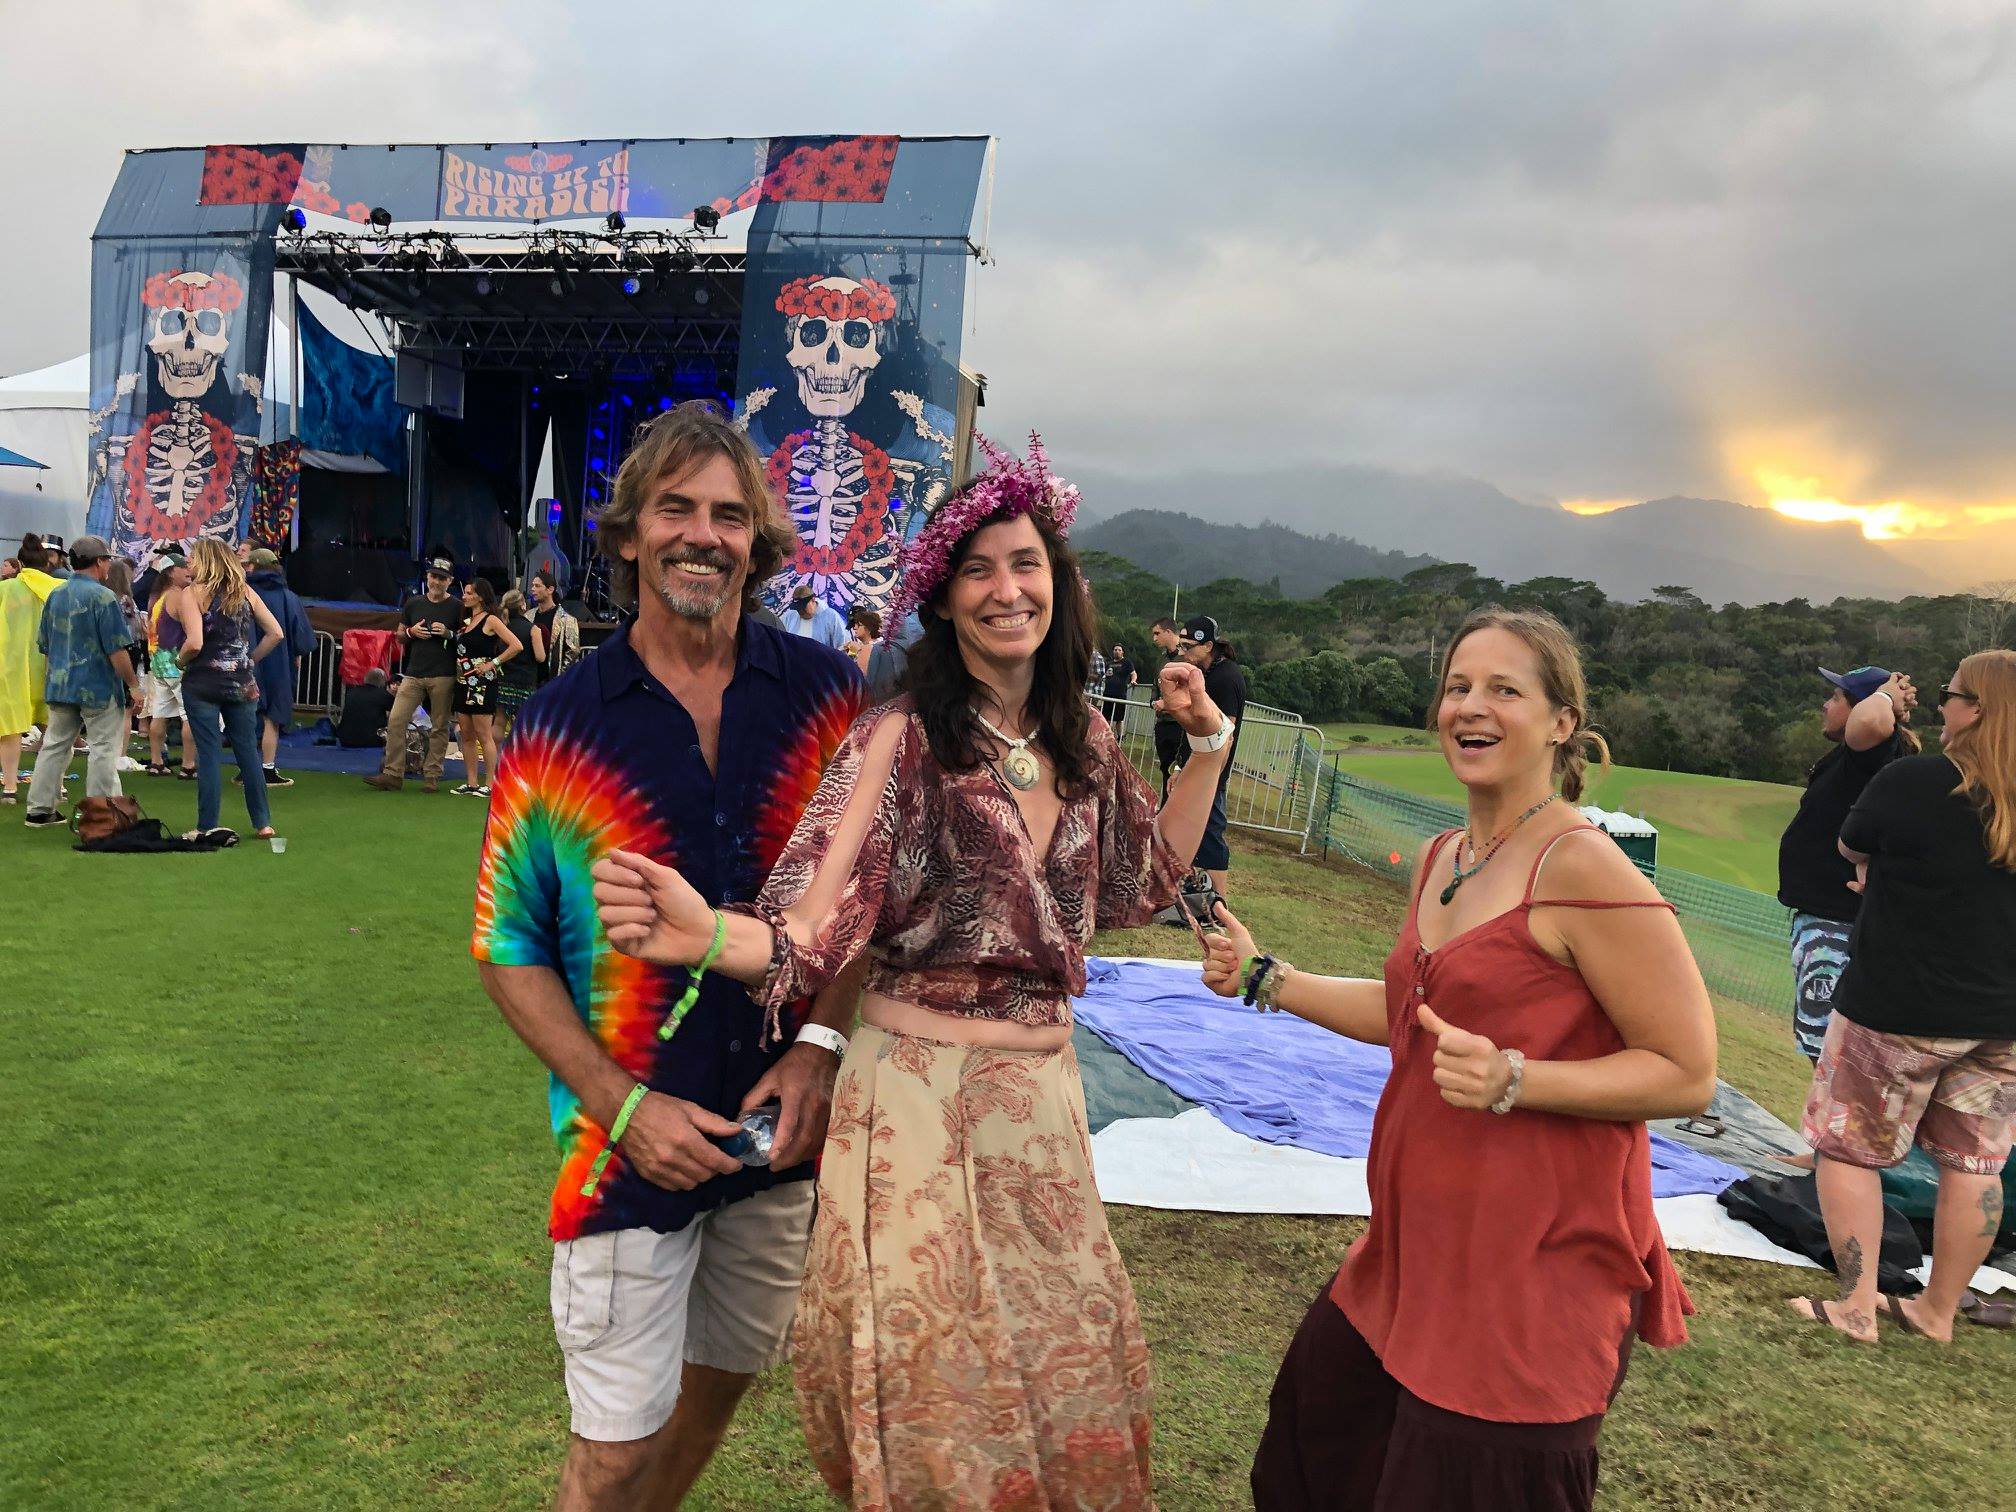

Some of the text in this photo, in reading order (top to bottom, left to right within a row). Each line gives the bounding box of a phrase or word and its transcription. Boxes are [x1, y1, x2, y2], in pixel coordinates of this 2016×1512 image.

[445, 149, 629, 197] RISING UP TO
[444, 177, 629, 219] PARADISE
